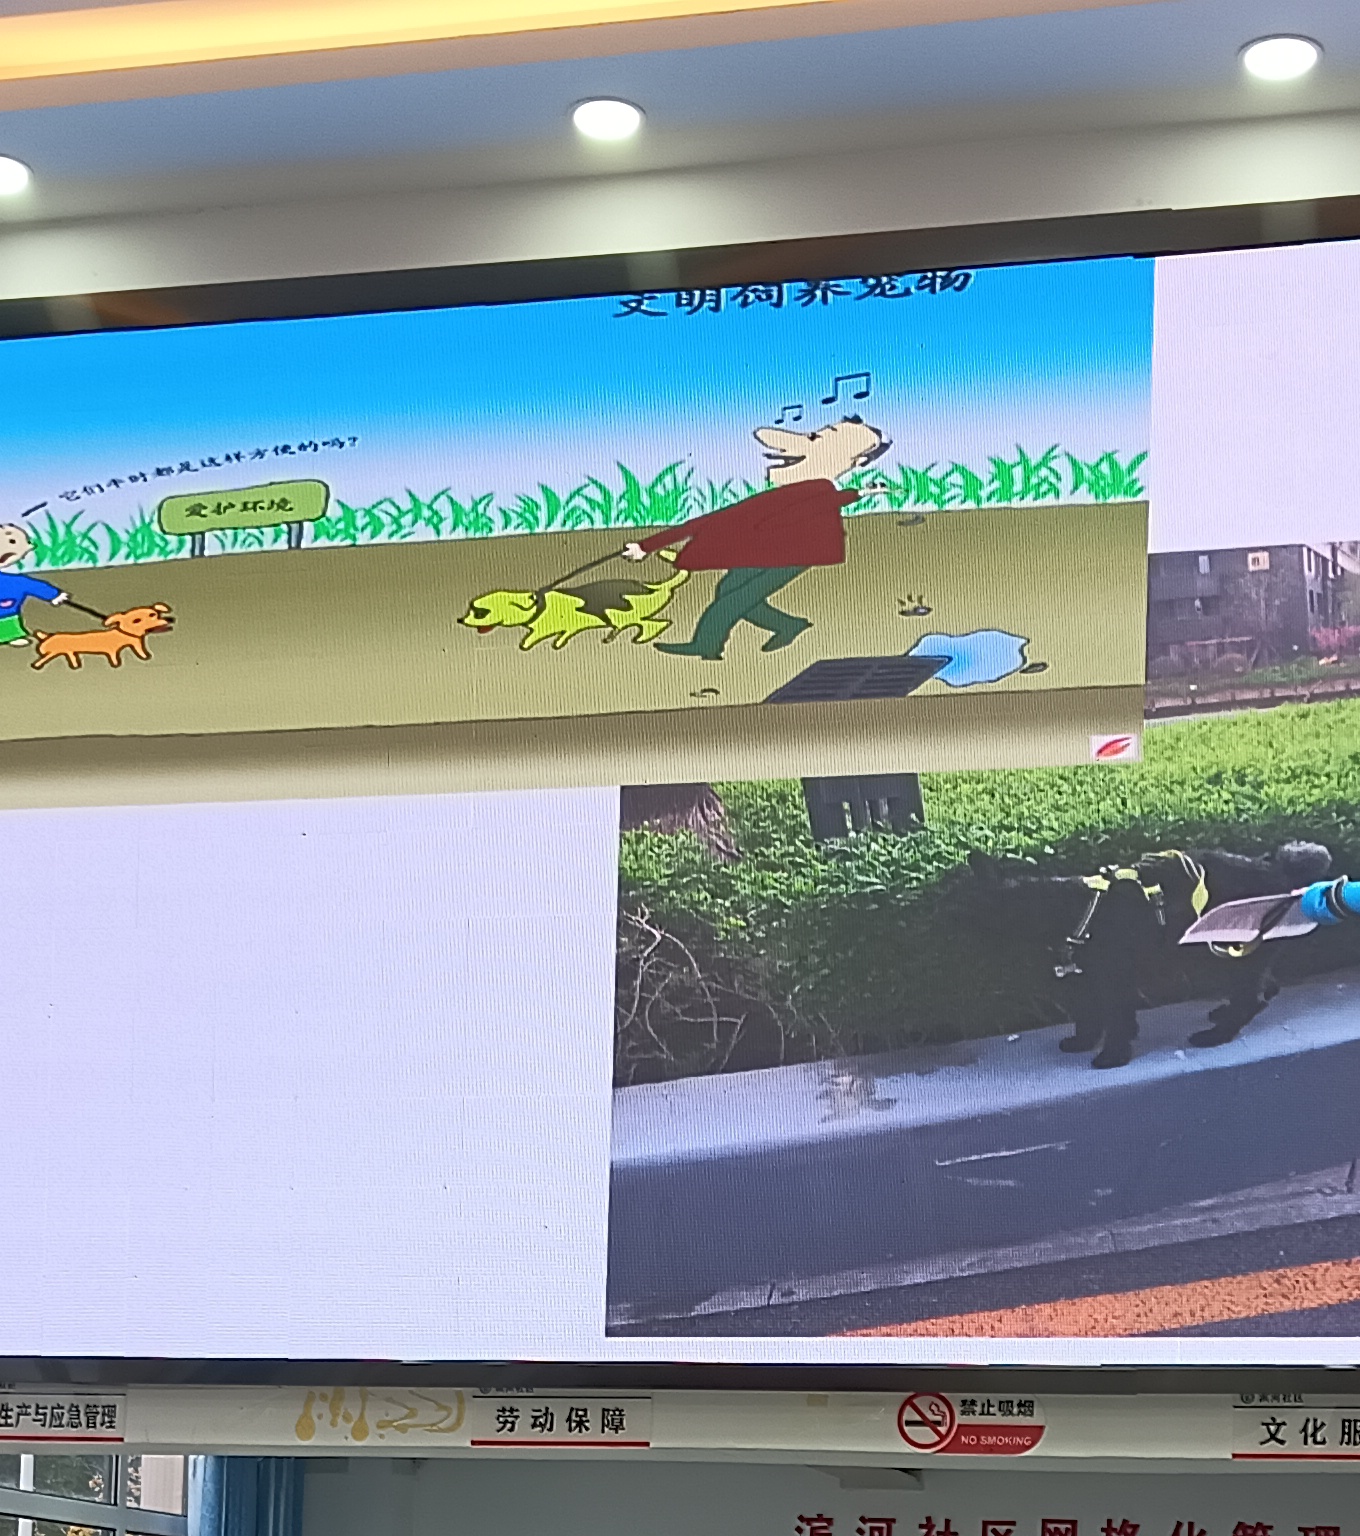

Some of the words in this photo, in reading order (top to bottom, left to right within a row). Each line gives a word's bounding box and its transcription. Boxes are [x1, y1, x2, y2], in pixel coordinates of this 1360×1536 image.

[185, 497, 294, 519] 爱护环境
[959, 1399, 1035, 1417] 禁止吸烟
[495, 1406, 628, 1434] 劳动保障
[961, 1435, 978, 1445] NO
[979, 1435, 1032, 1446] SMOKING
